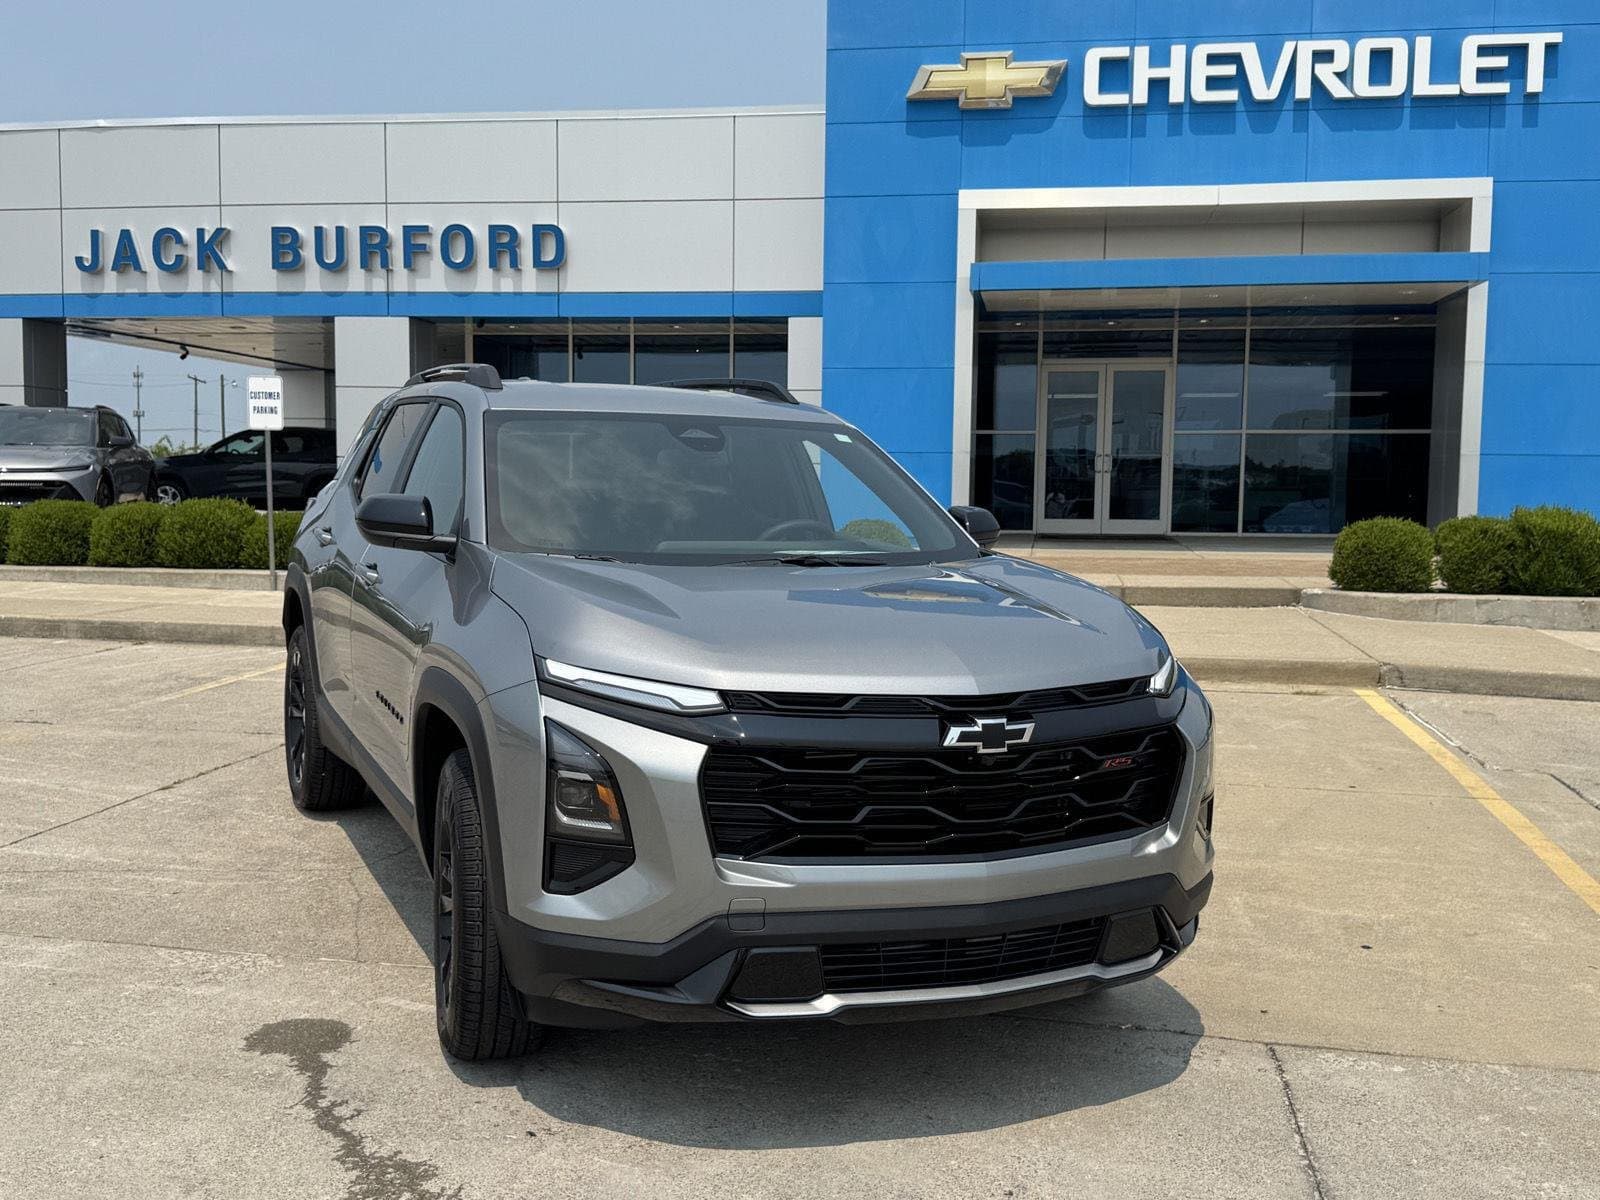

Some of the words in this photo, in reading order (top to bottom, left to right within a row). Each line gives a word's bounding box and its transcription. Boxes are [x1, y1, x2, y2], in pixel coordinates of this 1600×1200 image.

[1083, 32, 1563, 107] CHEVROLET
[75, 227, 233, 273] JACK
[271, 223, 567, 271] BURFORD
[250, 391, 281, 400] CUSTOMER
[253, 405, 278, 415] PARKING
[1104, 757, 1133, 768] RS
